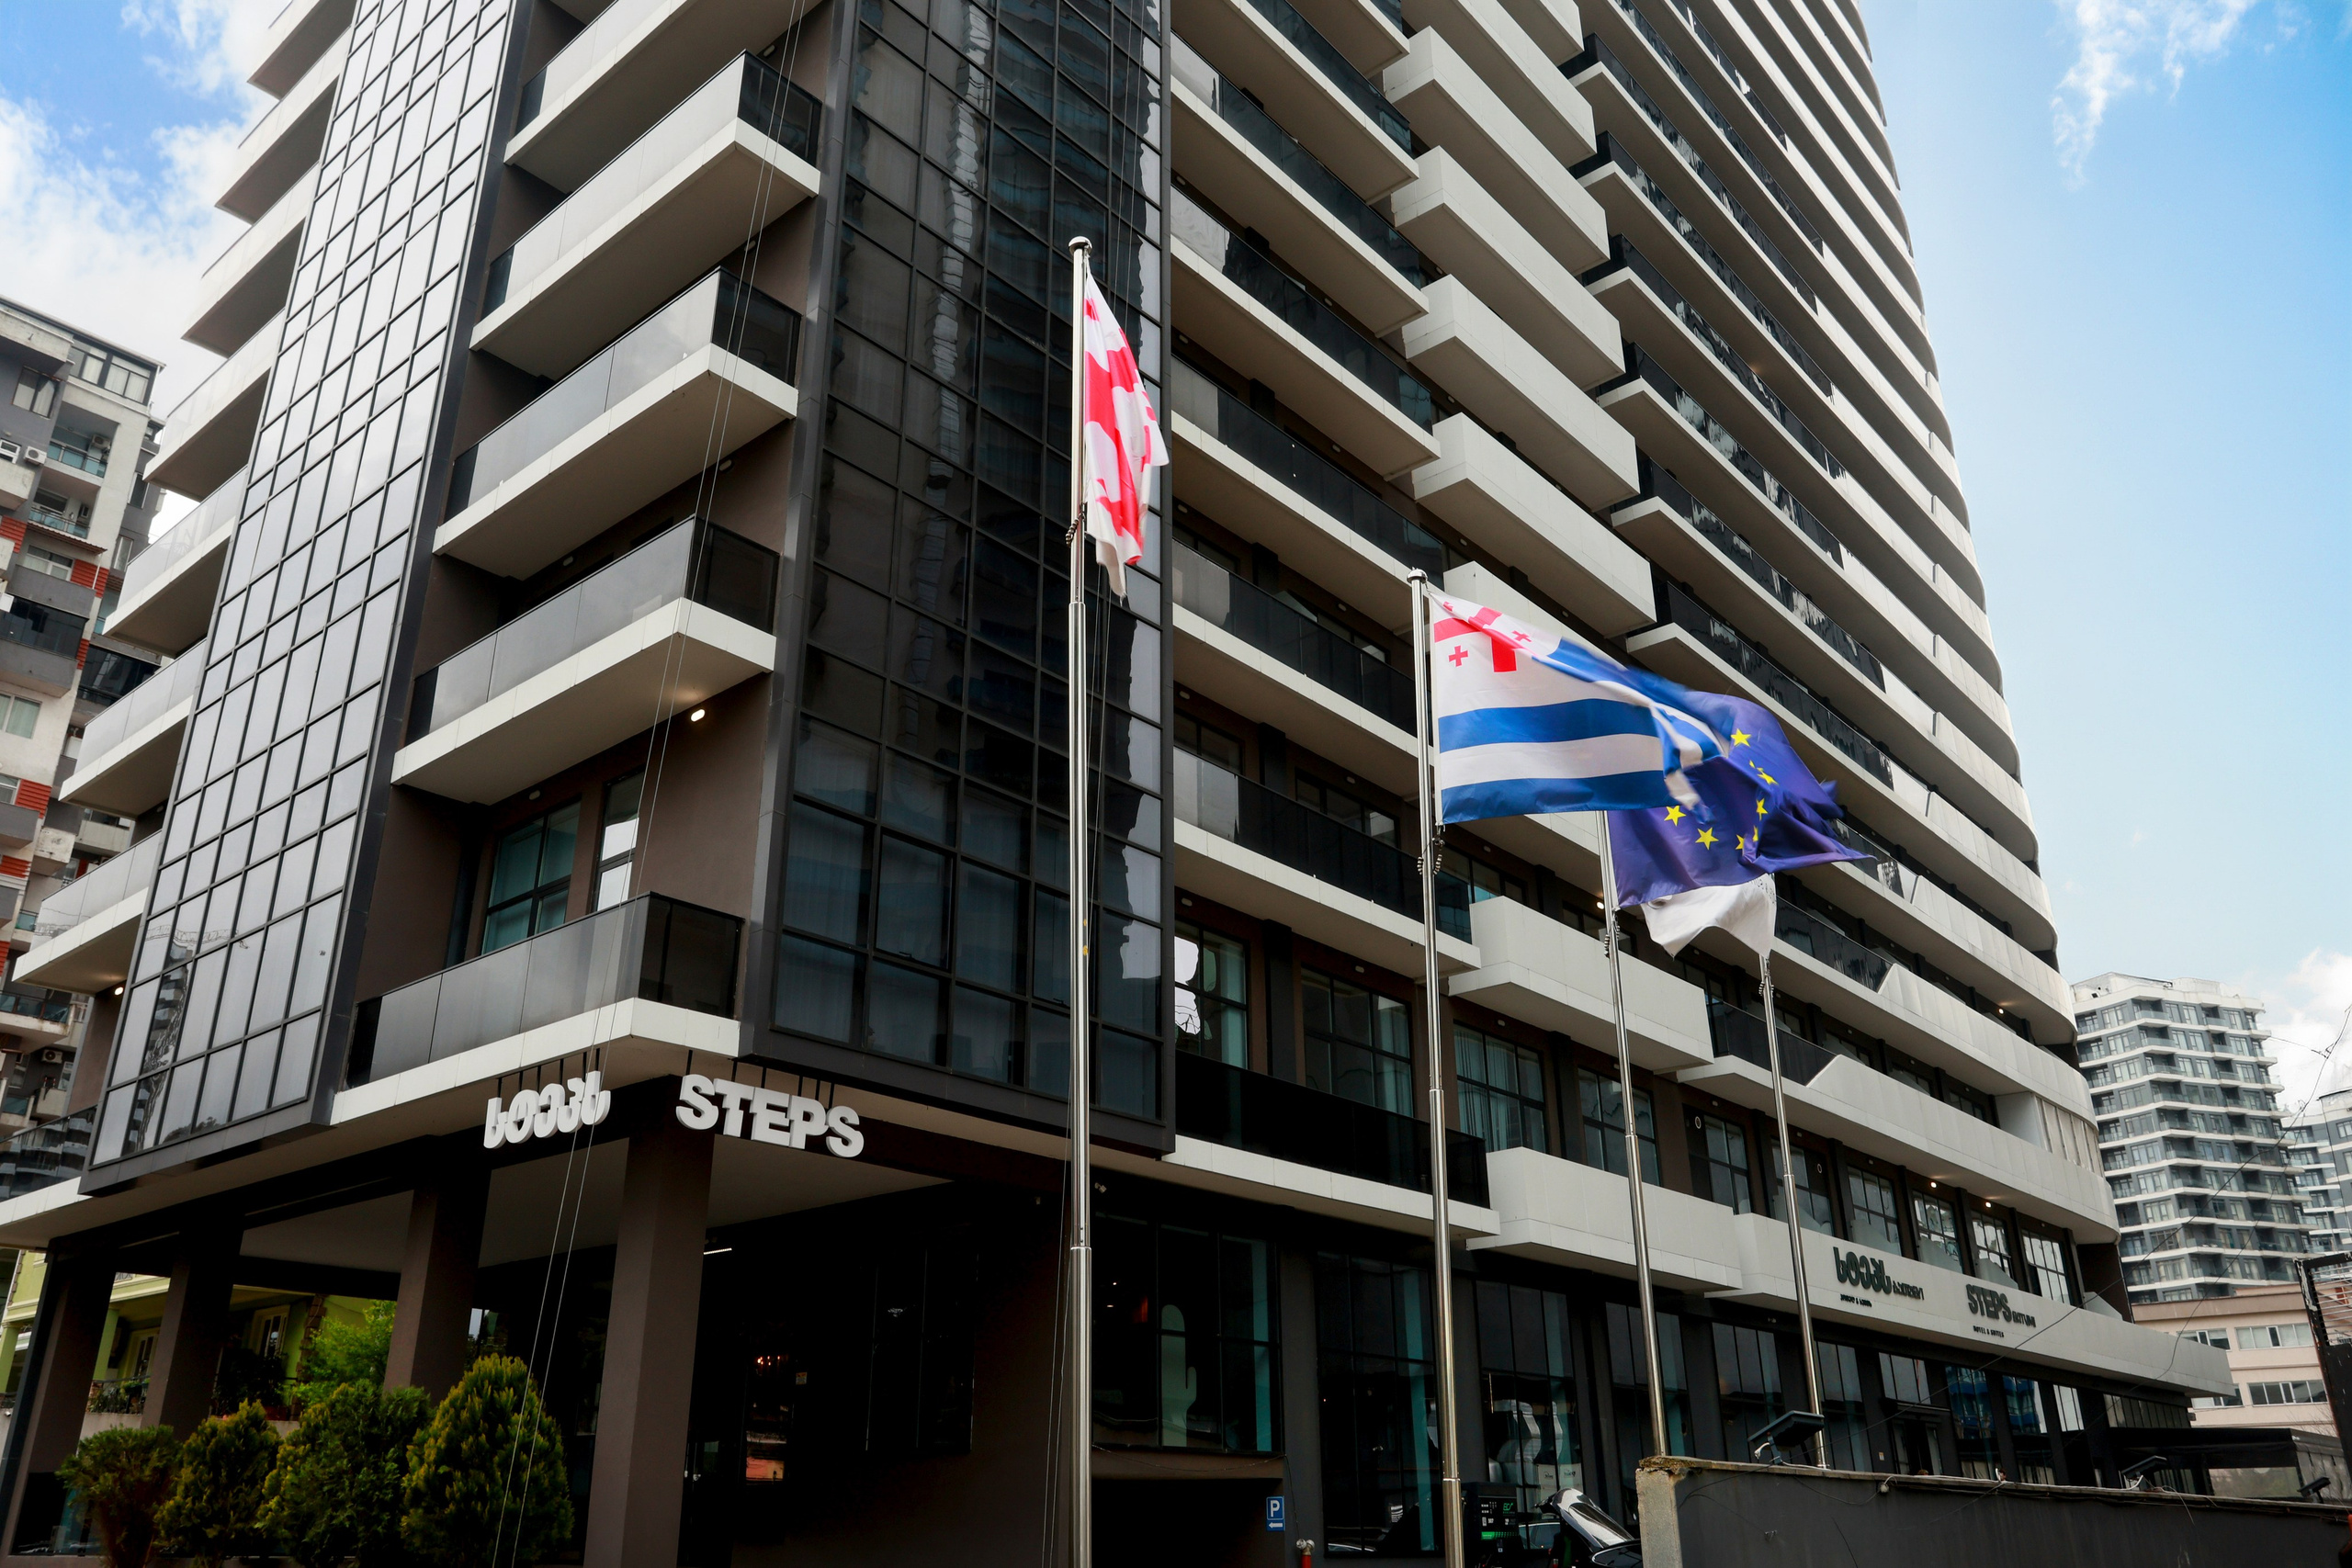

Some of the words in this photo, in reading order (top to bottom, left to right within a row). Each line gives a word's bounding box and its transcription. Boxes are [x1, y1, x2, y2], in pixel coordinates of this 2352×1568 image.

[675, 1074, 864, 1157] STEPS
[1965, 1283, 2012, 1323] STEPS
[1270, 1499, 1281, 1517] P
